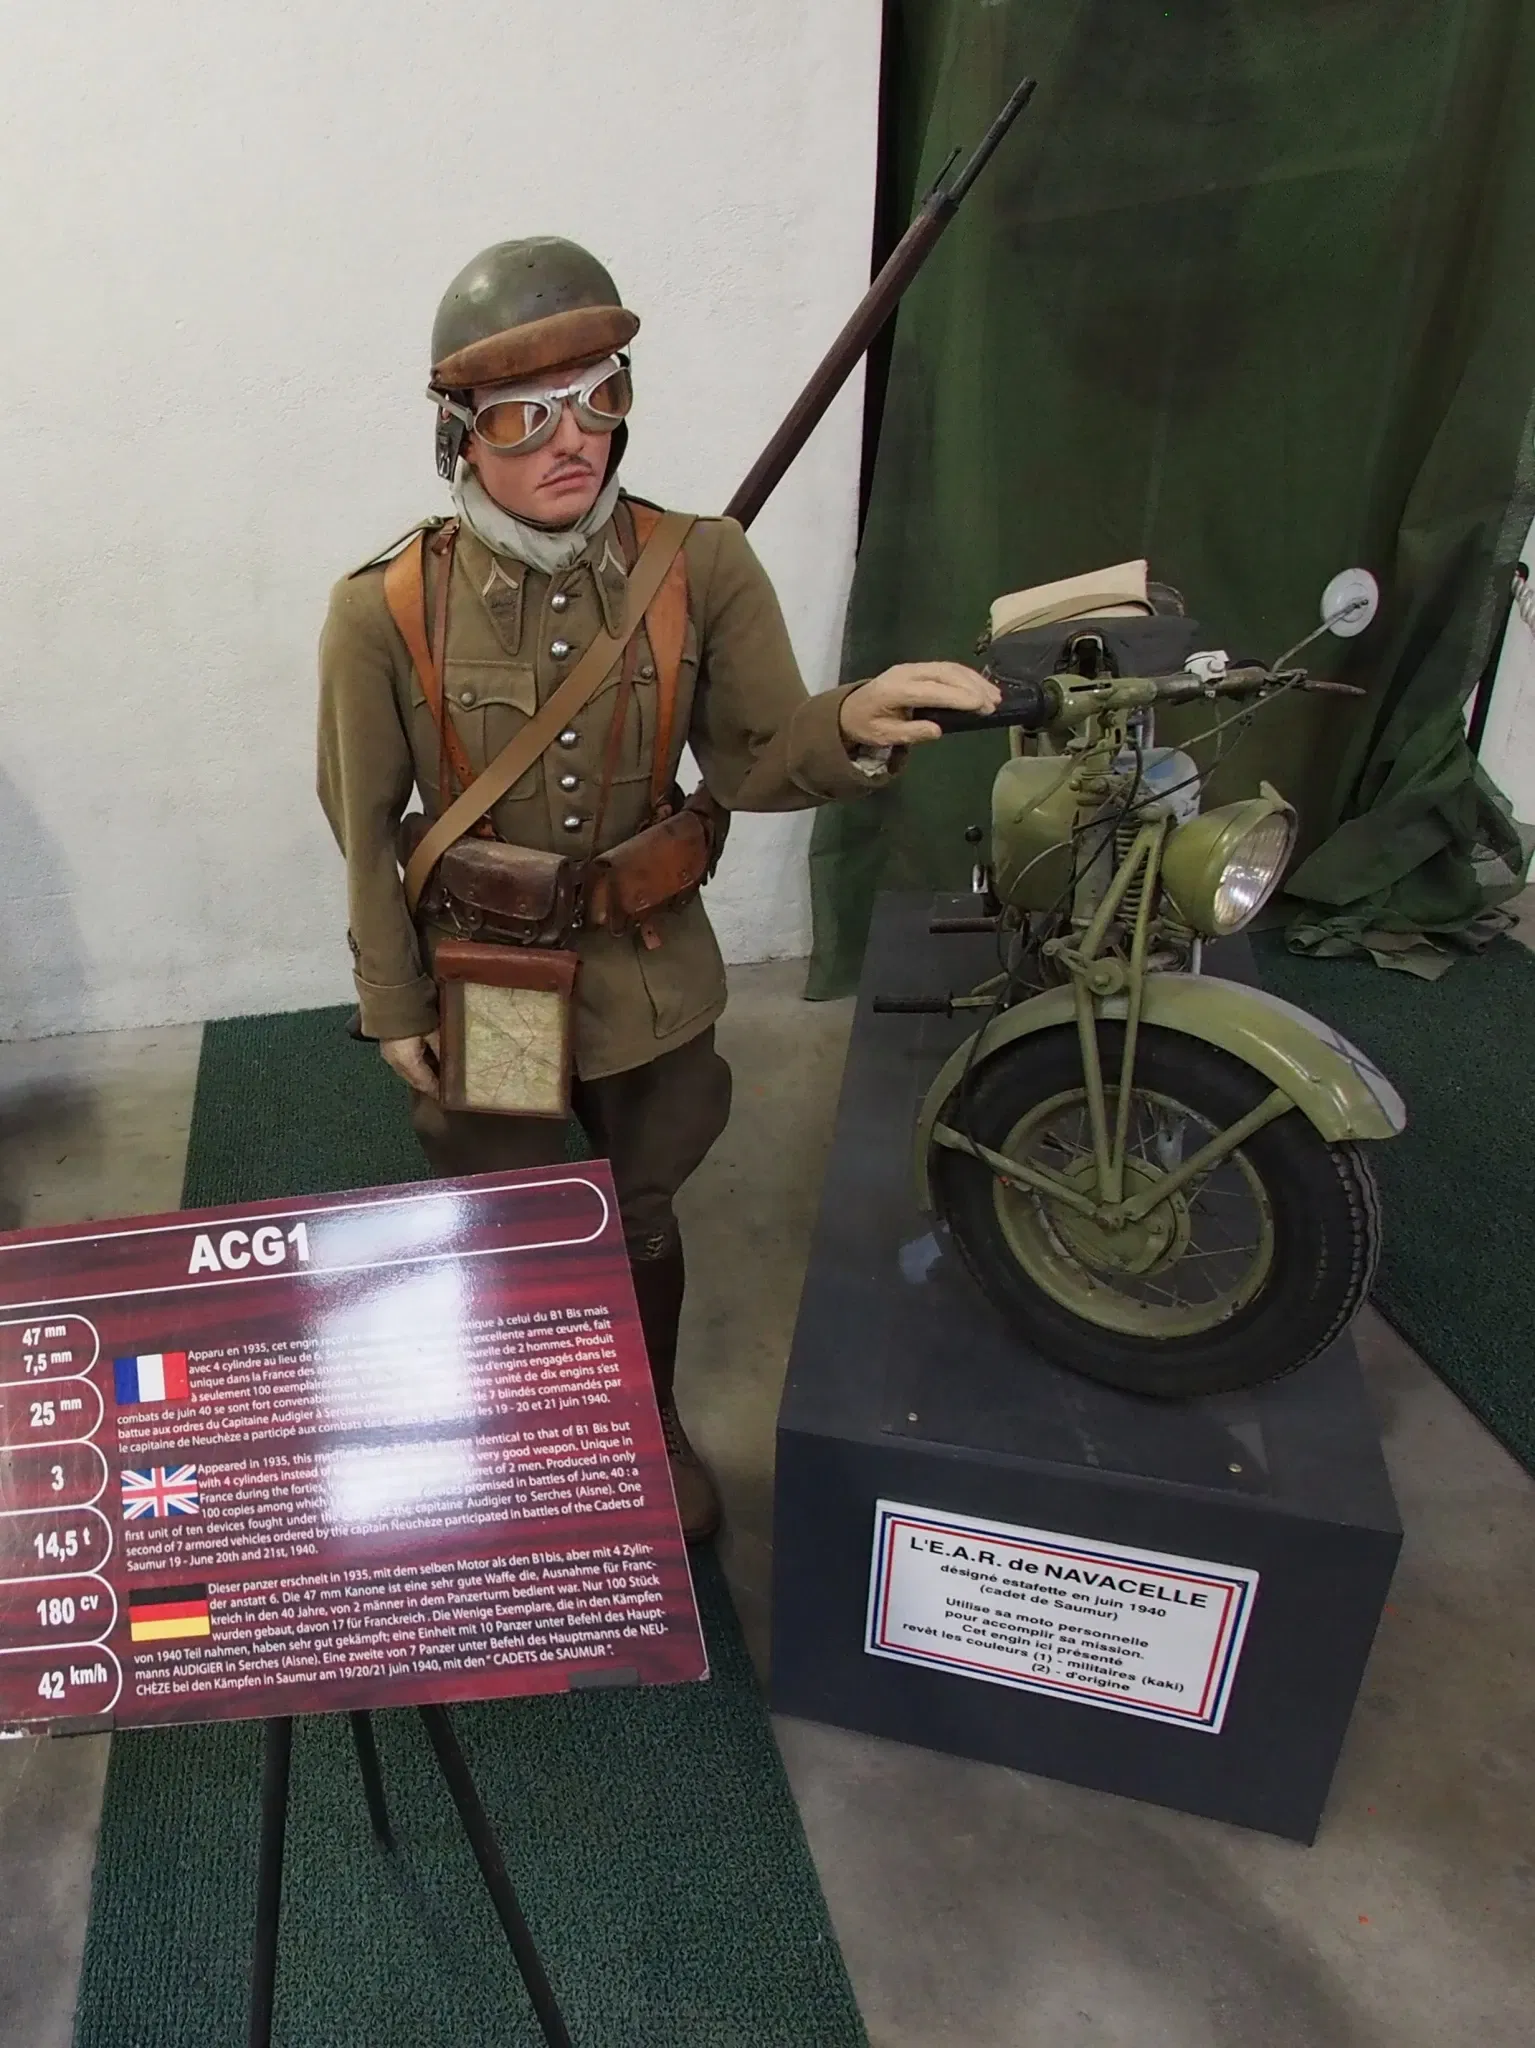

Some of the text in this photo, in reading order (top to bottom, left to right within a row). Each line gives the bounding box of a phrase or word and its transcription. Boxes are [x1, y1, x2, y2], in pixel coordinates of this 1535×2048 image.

[188, 1222, 310, 1275] ACG1
[22, 1325, 67, 1346] 47 mm
[473, 1330, 524, 1343] excellente
[527, 1327, 553, 1337] arme
[593, 1318, 611, 1330] fait
[502, 1343, 516, 1354] de
[525, 1339, 574, 1352] hommes.
[574, 1333, 614, 1346] Produit
[187, 1336, 318, 1361] Apparu en 1935, cet engin
[23, 1351, 73, 1376] 7,5 mm
[30, 1398, 82, 1427] 25 mm
[117, 1410, 313, 1439] battue aux ordres du Capitaine Audigier
[118, 1442, 128, 1452] le
[129, 1438, 175, 1453] capitaine
[176, 1436, 190, 1447] de
[191, 1432, 241, 1446] Neuchèze
[251, 1424, 296, 1442] participé
[297, 1425, 316, 1434] aux
[475, 1421, 630, 1445] identical to that of B1 Bis but
[477, 1435, 633, 1461] very good weapon. Unique in
[51, 1465, 65, 1491] 3
[197, 1452, 312, 1476] Appeared in 1935, this
[198, 1476, 221, 1488] with
[232, 1471, 279, 1487] cylinders
[280, 1465, 318, 1480] instead
[467, 1481, 641, 1508] Audigier to Serches (Aisne). One
[125, 1512, 317, 1541] first unit of ten devices fought under
[34, 1527, 91, 1563] 14,5 t
[209, 1560, 657, 1609] der anstatt 6. Die 47 mm Kanone ist eine sehr gute Waffe die, Ausnahme für Franc-
[910, 1536, 1207, 1608] L'E.A.R. de NAVACELLE
[210, 1611, 242, 1625] kreich
[244, 1611, 256, 1622] in
[257, 1608, 279, 1621] den
[280, 1607, 294, 1618] 40
[296, 1605, 328, 1618] Jahre,
[329, 1604, 350, 1614] von
[363, 1599, 404, 1611] männer
[406, 1596, 417, 1607] in
[419, 1594, 445, 1606] dem
[447, 1590, 510, 1603] Panzerturm
[511, 1584, 555, 1598] bedient
[556, 1583, 580, 1593] war.
[940, 1564, 1166, 1617] désigné estafette en juin 1940
[979, 1584, 1117, 1621] (cadet de Saumur)
[36, 1595, 99, 1627] 180 cv
[946, 1597, 1148, 1647] Utilise sa moto personnelle
[944, 1610, 1143, 1658] pour accomplir sa mission.
[962, 1624, 1122, 1665] Cet engin ici présenté
[135, 1668, 170, 1679] manns
[172, 1661, 223, 1676] AUDIGIER
[225, 1660, 236, 1671] in
[238, 1657, 279, 1670] Serches
[281, 1652, 321, 1668] (Aisne).
[322, 1651, 346, 1663] Eine
[348, 1648, 383, 1661] zweite
[386, 1647, 407, 1657] von
[418, 1643, 455, 1655] Panzer
[457, 1640, 487, 1651] unter
[489, 1634, 525, 1649] Befehl
[526, 1633, 547, 1645] des
[548, 1629, 621, 1644] Hauptmanns
[622, 1625, 637, 1637] de
[639, 1622, 668, 1635] NEU-
[941, 1630, 961, 1641] les
[966, 1638, 1028, 1656] couleurs
[1033, 1651, 1052, 1663] (1)
[1067, 1660, 1135, 1680] militaires
[1141, 1676, 1184, 1692] (kaki)
[38, 1663, 108, 1700] 42 km/h
[1031, 1662, 1050, 1674] (2)
[1065, 1671, 1130, 1691] d'origine
